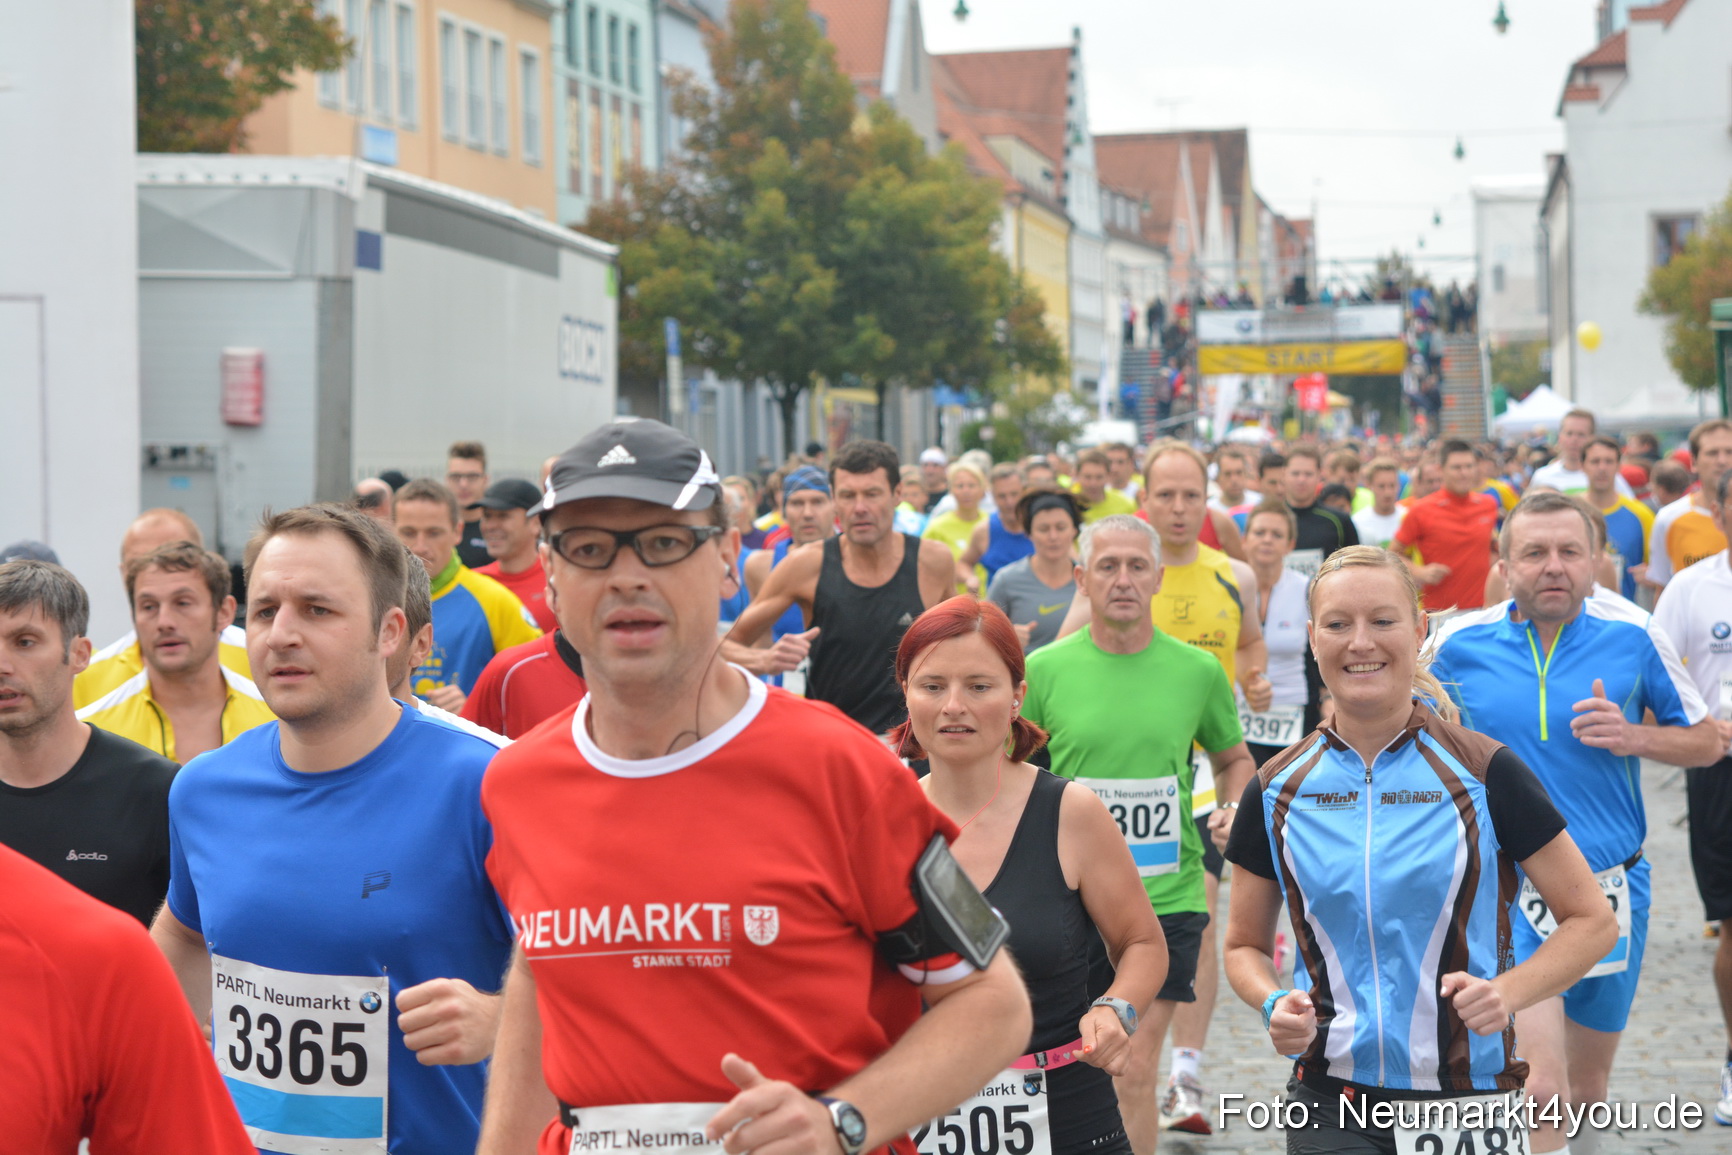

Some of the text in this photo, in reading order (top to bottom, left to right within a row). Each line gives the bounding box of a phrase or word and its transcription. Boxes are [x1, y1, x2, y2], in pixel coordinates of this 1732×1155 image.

[1266, 349, 1336, 368] START
[1240, 713, 1295, 741] 3397
[1114, 788, 1164, 799] Neumarkt
[78, 852, 108, 861] odlo
[519, 903, 730, 949] NEUMARKT
[632, 955, 732, 969] STARKE STADT
[216, 972, 351, 1011] PARTL Neumarkt
[228, 1004, 368, 1087] 3365
[572, 1130, 622, 1151] PARTL
